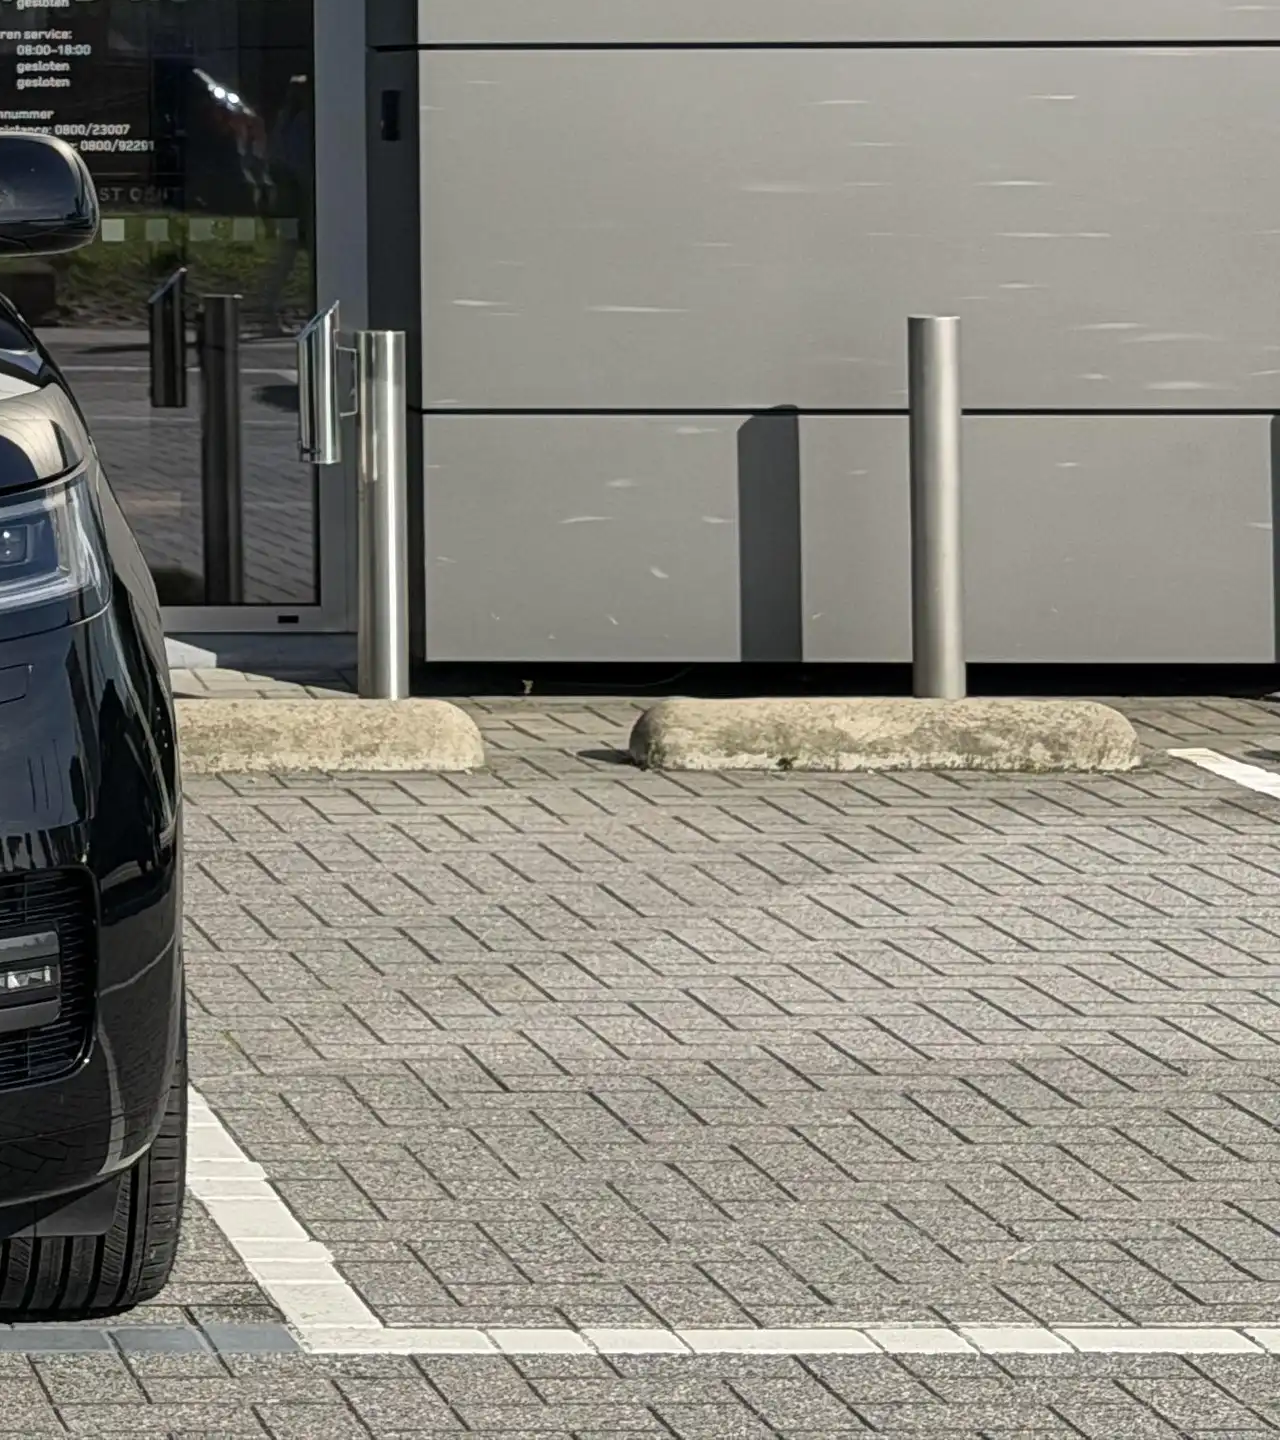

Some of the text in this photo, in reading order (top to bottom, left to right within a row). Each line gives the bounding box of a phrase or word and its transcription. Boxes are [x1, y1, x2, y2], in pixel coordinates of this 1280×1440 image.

[23, 29, 73, 40] service:
[16, 61, 70, 74] gesloten
[16, 77, 71, 90] gesloten
